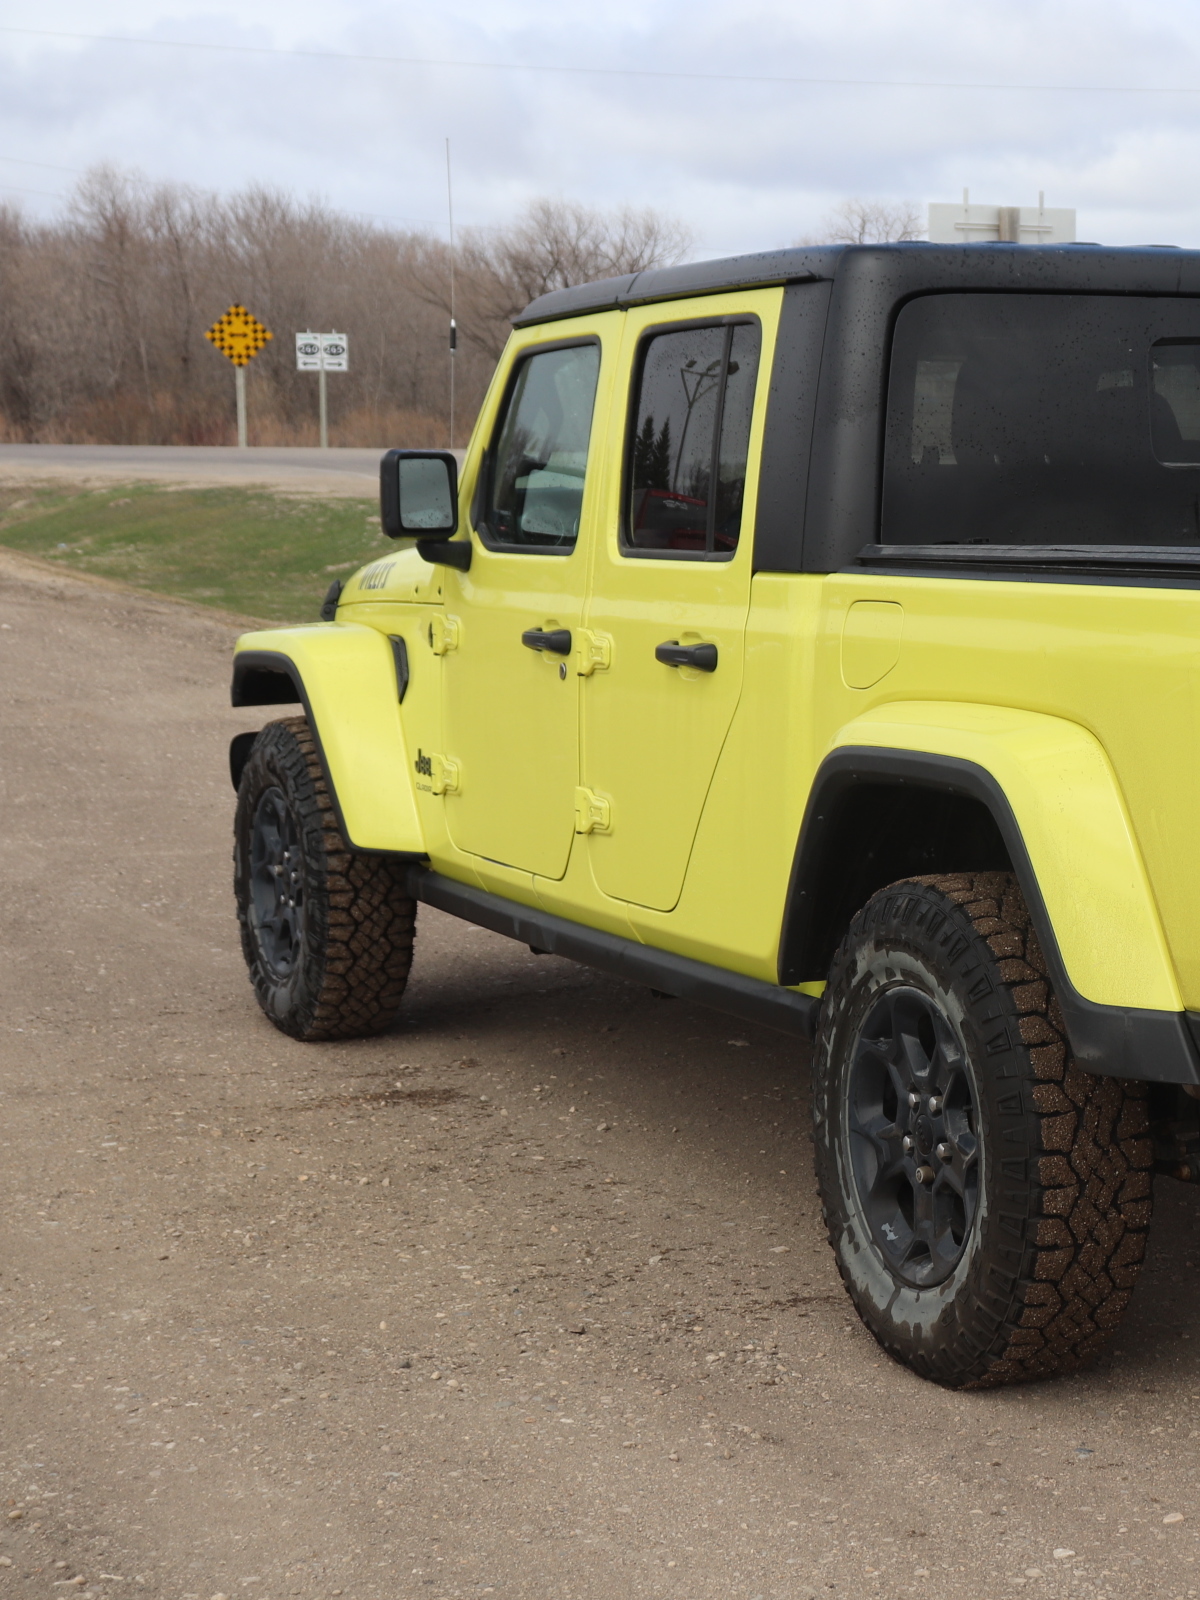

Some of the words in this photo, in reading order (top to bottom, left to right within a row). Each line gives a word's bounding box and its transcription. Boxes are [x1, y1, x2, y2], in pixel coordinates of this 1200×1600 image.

[300, 344, 318, 353] 260
[325, 345, 343, 354] 265
[415, 748, 432, 777] Jee
